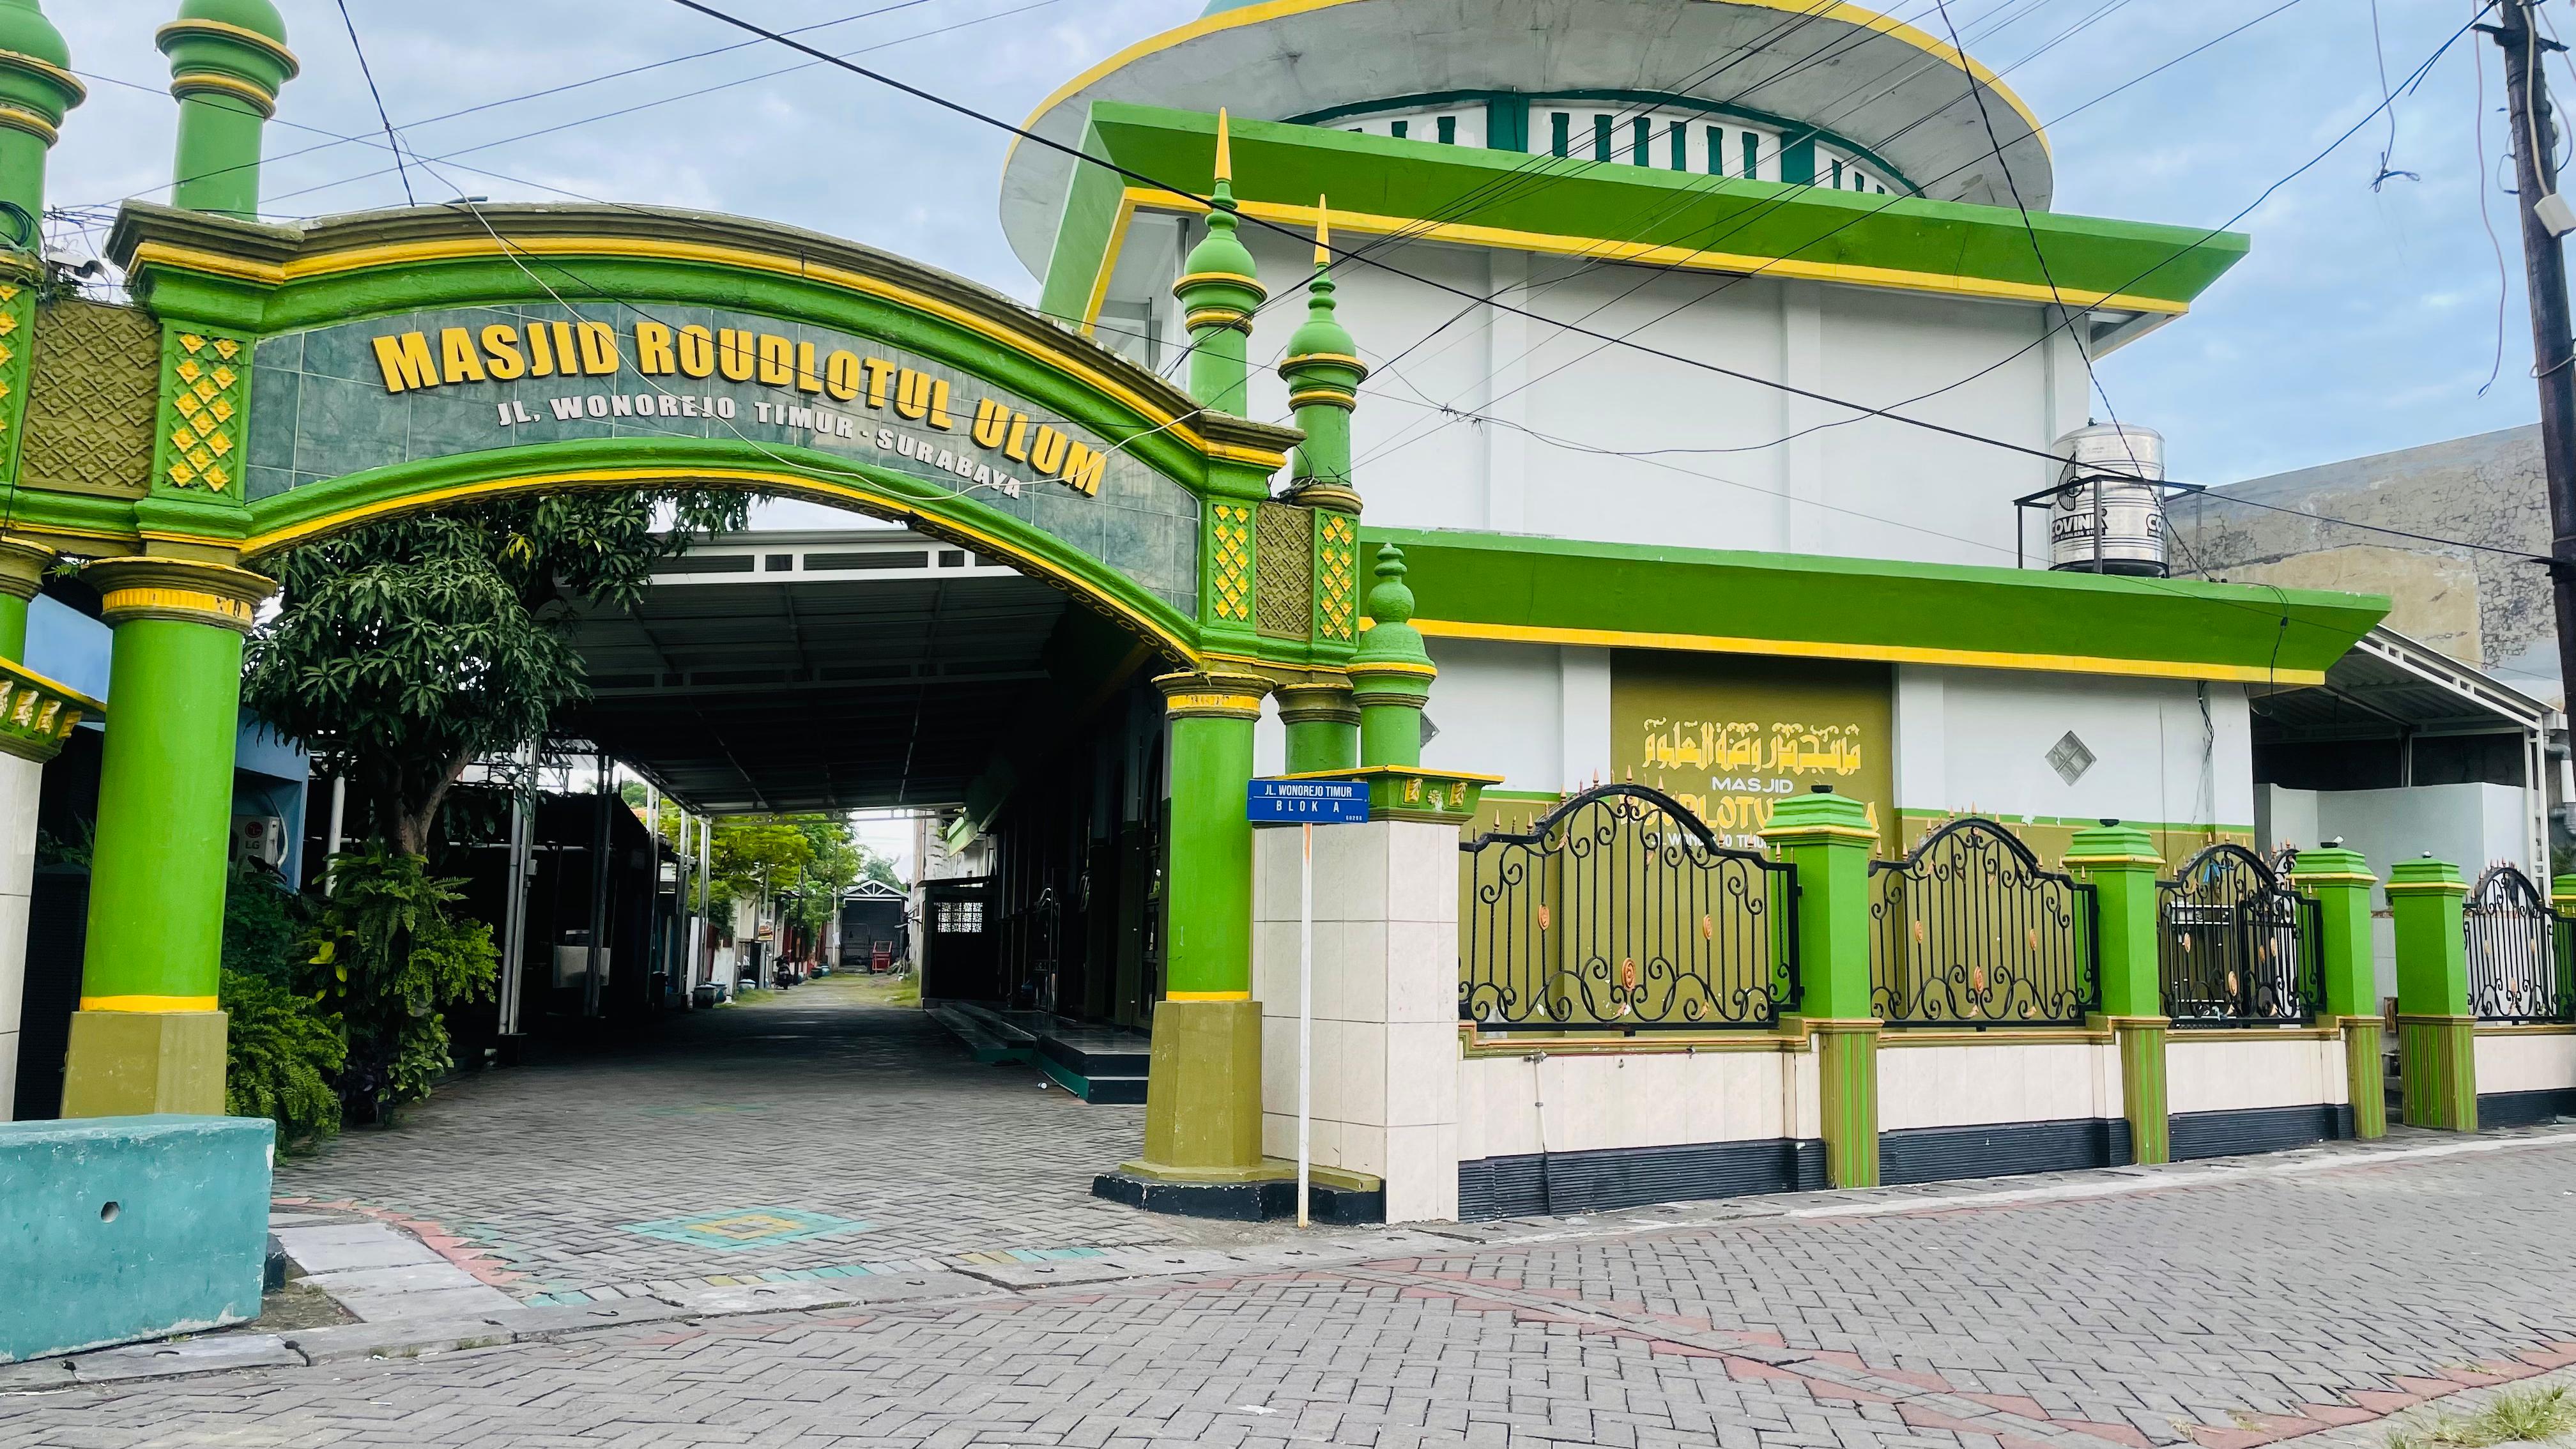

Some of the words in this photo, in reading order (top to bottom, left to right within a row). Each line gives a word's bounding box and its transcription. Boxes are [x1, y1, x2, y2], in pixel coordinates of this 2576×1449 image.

[372, 321, 620, 394] MASJID
[635, 321, 953, 430] ROUDLOTUL
[972, 397, 1107, 498] ULUM
[550, 394, 736, 420] WONOREJO
[754, 401, 853, 438] TIMUR
[877, 428, 1021, 500] SURABAYA
[1264, 785, 1276, 795] JL.
[1278, 785, 1323, 797] WONOREJO
[1326, 786, 1352, 797] TIMUR
[1712, 776, 1794, 794] MASJID
[1276, 801, 1318, 812] BLOK
[1333, 801, 1340, 813] A
[245, 841, 259, 849] LG
